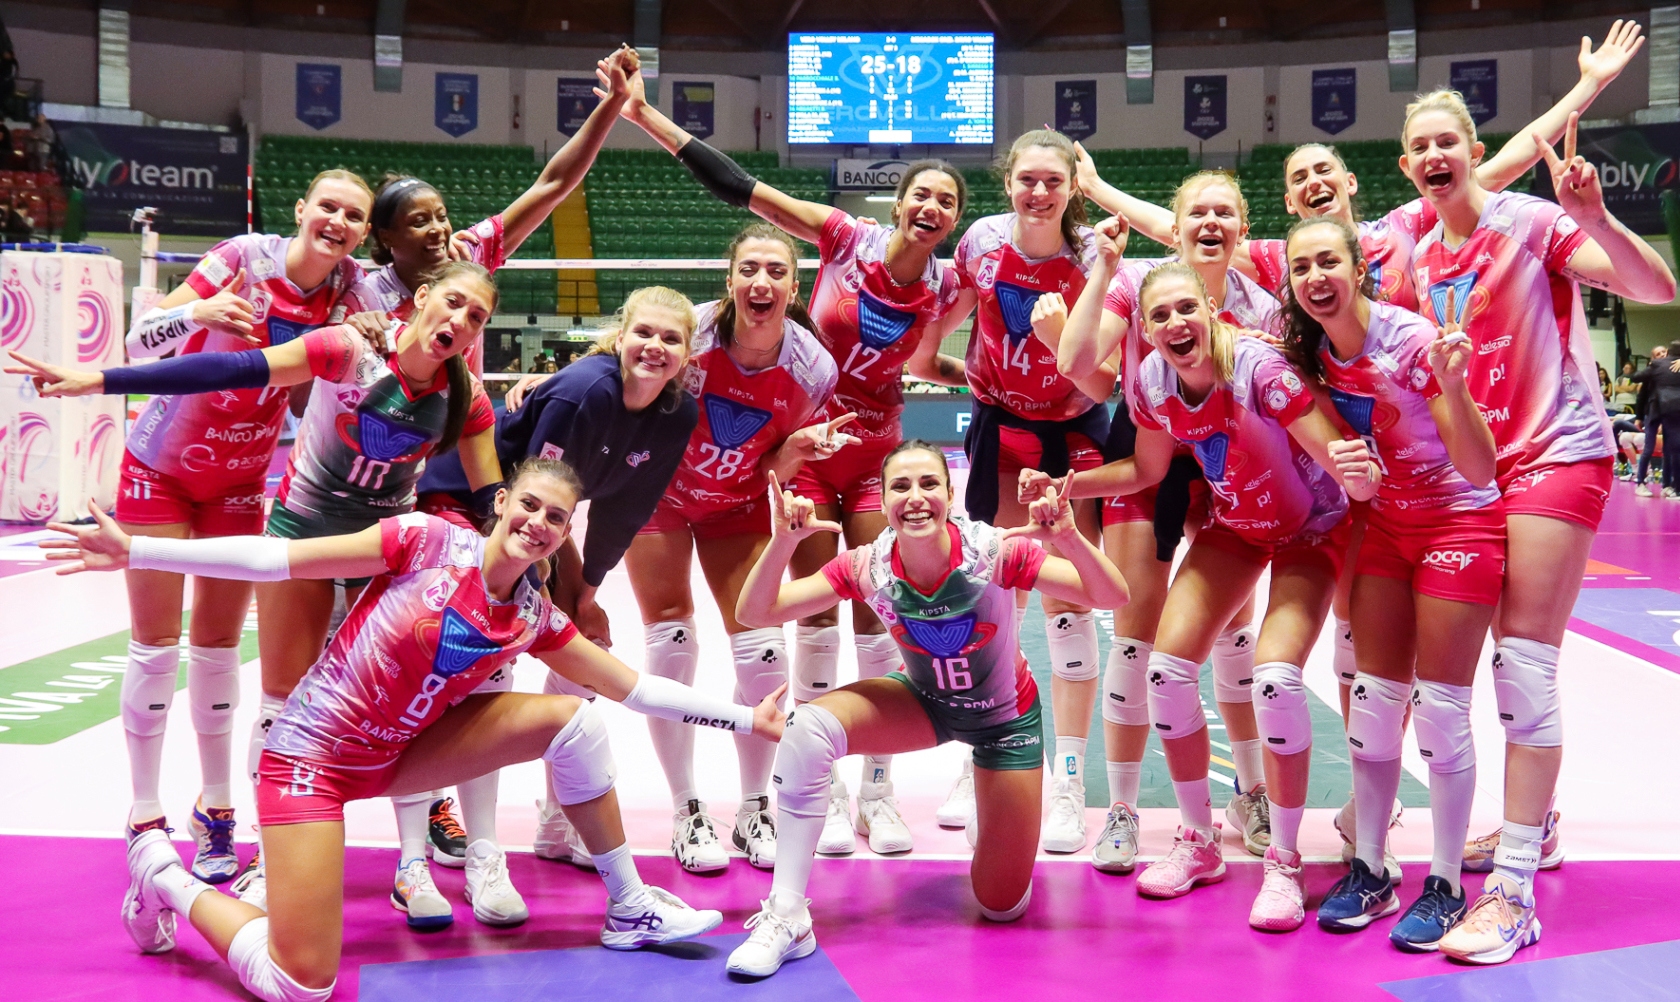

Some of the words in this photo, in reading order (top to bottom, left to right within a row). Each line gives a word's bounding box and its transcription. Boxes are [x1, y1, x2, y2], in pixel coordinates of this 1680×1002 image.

[861, 55, 921, 74] 25-18
[130, 160, 213, 189] team
[843, 171, 902, 185] BANCO
[140, 318, 189, 350] KIPSTA
[1480, 339, 1511, 352] telesia
[842, 342, 882, 381] 12
[1002, 333, 1031, 376] 14
[1042, 374, 1058, 389] p!
[1489, 363, 1505, 386] p!
[728, 387, 754, 401] KIPSTA
[387, 406, 415, 422] KIPSTA
[859, 408, 884, 421] BPM
[1025, 401, 1051, 412] BPM
[205, 427, 252, 443] BANCO
[1187, 425, 1213, 436] KIPSTA
[695, 442, 745, 481] 28
[128, 464, 160, 480] KIPSTA
[1257, 491, 1272, 508] p!
[1252, 520, 1280, 530] BPM
[919, 605, 950, 616] KIPSTA
[471, 609, 491, 634] KIPSTA
[374, 646, 402, 673] Sinergy
[932, 657, 973, 690] 16
